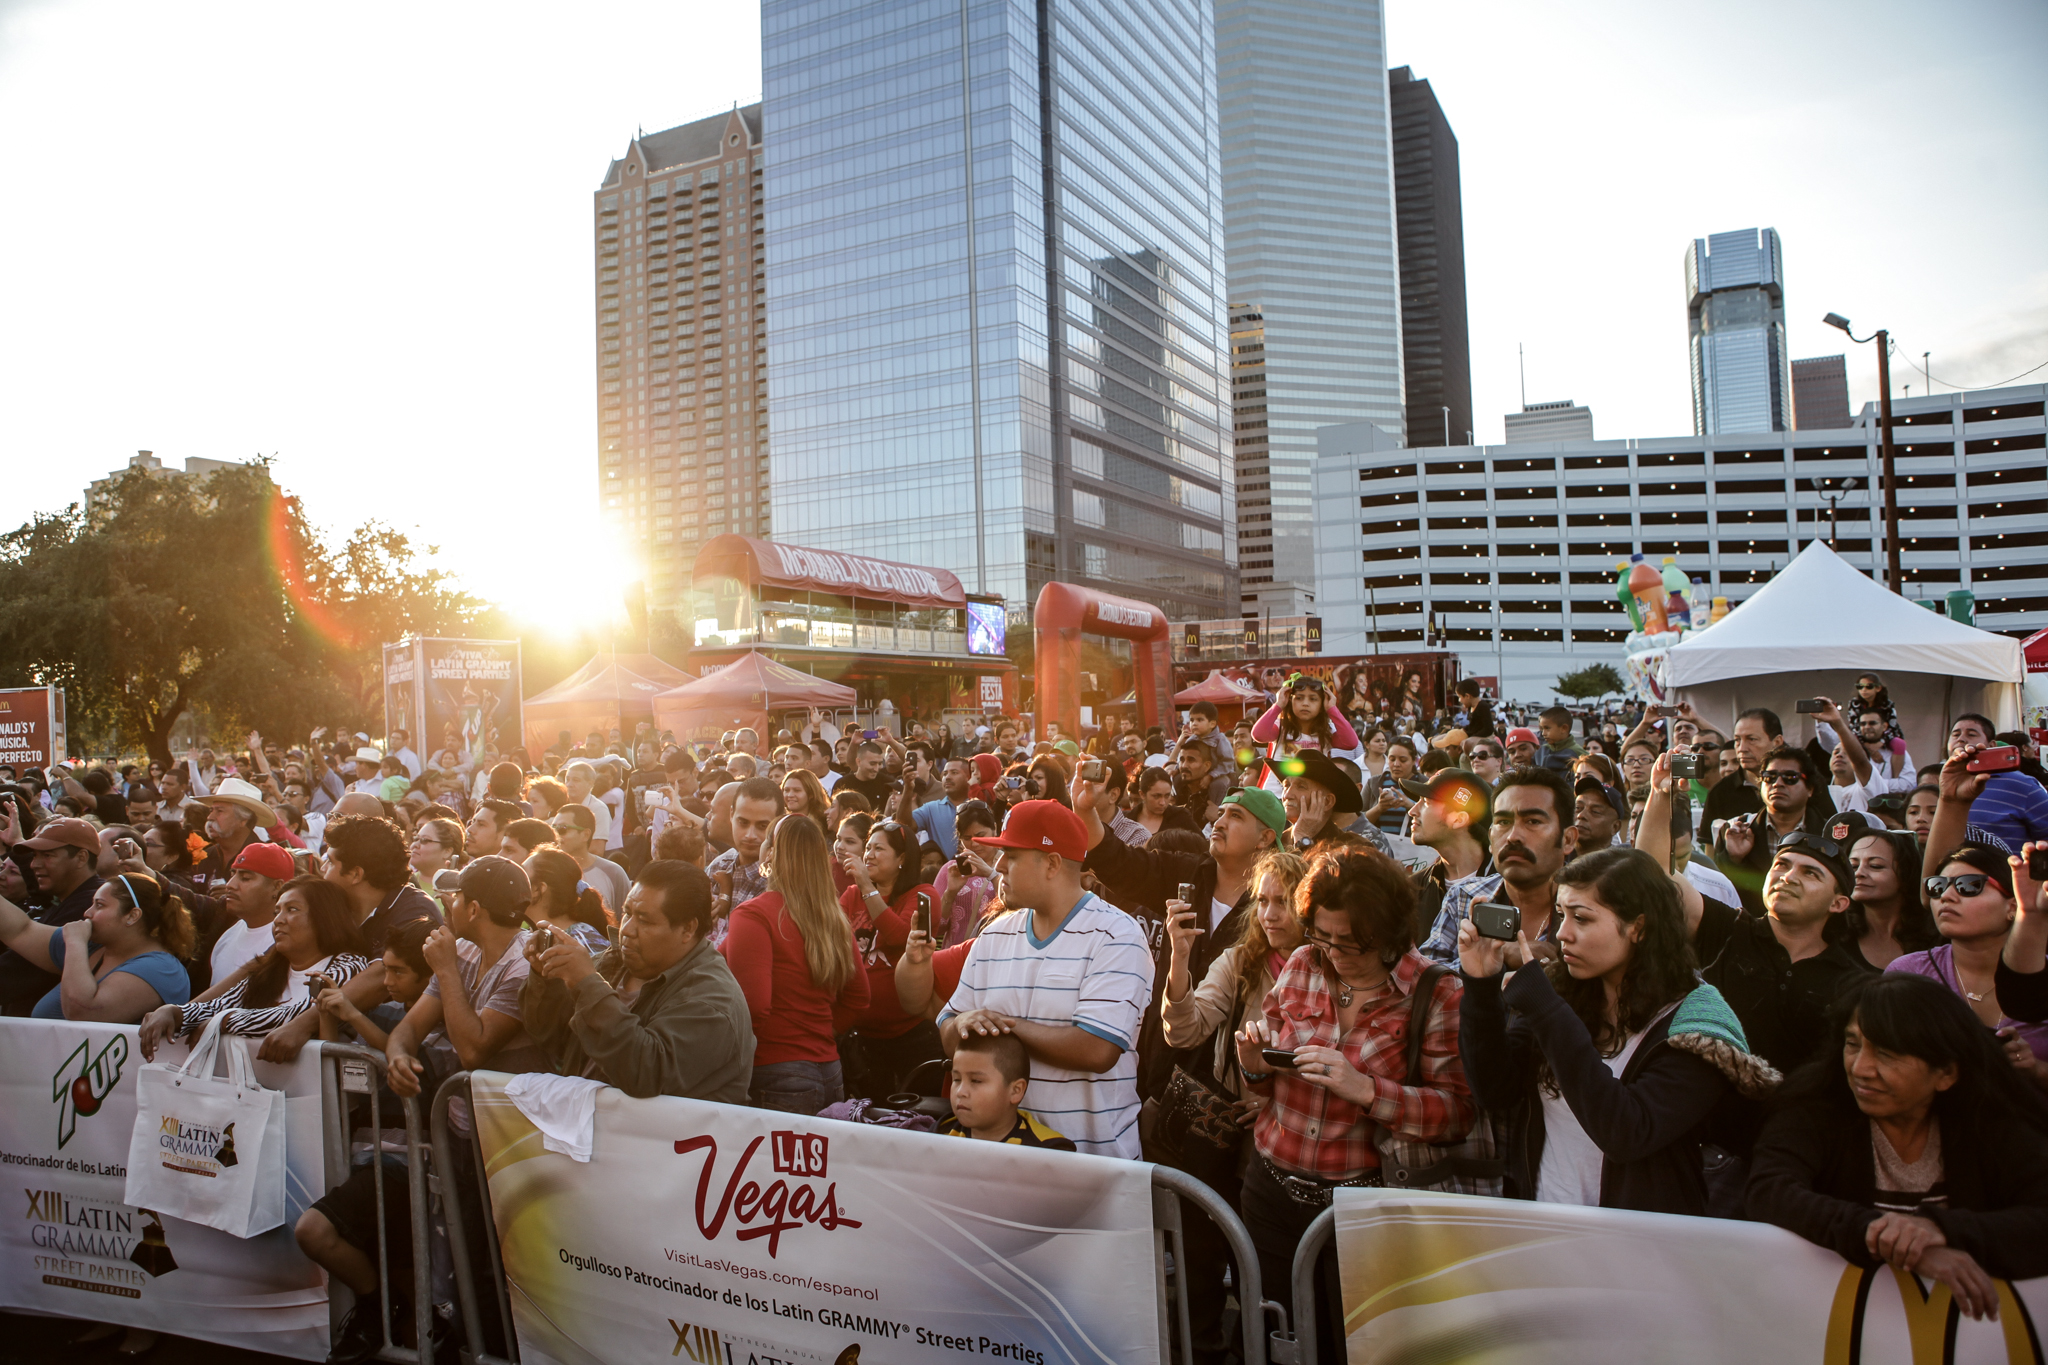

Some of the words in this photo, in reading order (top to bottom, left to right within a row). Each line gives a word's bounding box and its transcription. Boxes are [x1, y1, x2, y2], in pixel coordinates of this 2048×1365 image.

[431, 659, 463, 669] LATIN
[465, 660, 511, 670] GRAMMY
[431, 669, 468, 679] STREET
[469, 670, 511, 680] PARTIES
[981, 683, 1003, 700] FIESTA
[29, 722, 35, 733] Y
[159, 1116, 179, 1136] XIII
[178, 1124, 220, 1144] LATIN
[160, 1135, 218, 1157] GRAMMY
[774, 1134, 825, 1174] LAS
[66, 1157, 79, 1172] de
[81, 1159, 96, 1174] los
[98, 1162, 127, 1178] Latin
[25, 1188, 63, 1224] XIII
[64, 1200, 132, 1234] LATIN
[34, 1254, 84, 1277] STREET
[89, 1263, 147, 1287] PARTIES
[664, 1248, 879, 1301] VisitLasVegas.com/espanol
[45, 1276, 73, 1287] TENTH
[77, 1281, 138, 1298] ANNIVERSARY
[559, 1248, 622, 1279] Orgulloso
[625, 1266, 718, 1302] Patrocinador
[722, 1289, 742, 1308] de
[746, 1293, 769, 1313] los
[773, 1299, 813, 1323] Latin
[916, 1327, 974, 1353] Street
[978, 1336, 1045, 1365] Parties
[667, 1318, 723, 1365] XIII
[725, 1333, 775, 1351] ENTREGA
[785, 1348, 822, 1362] ANUAL
